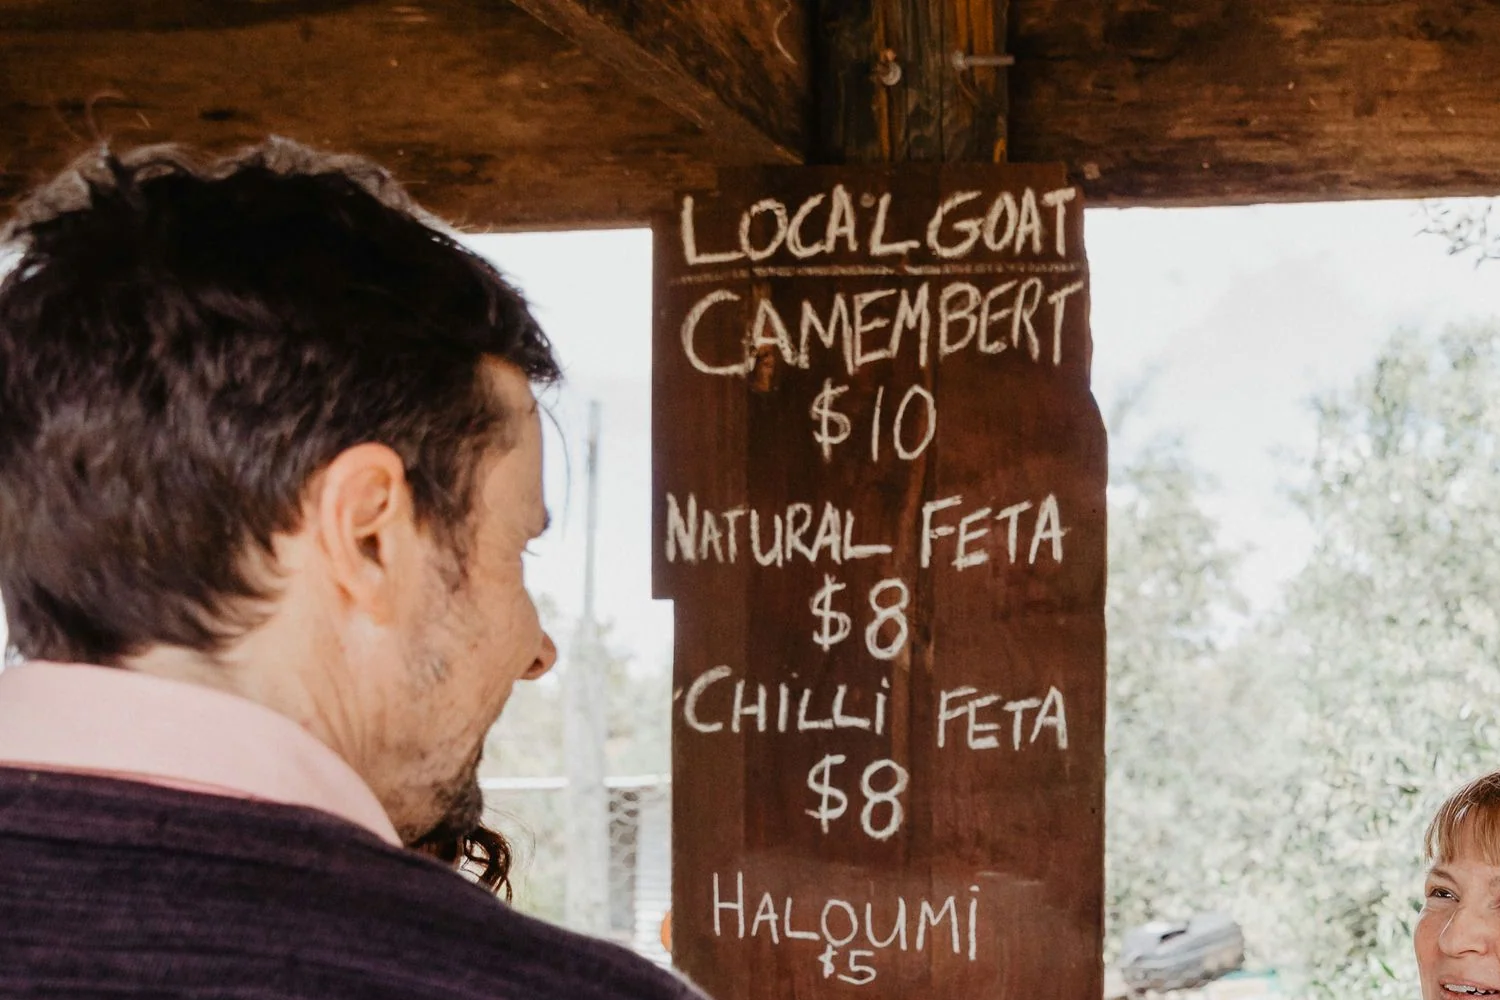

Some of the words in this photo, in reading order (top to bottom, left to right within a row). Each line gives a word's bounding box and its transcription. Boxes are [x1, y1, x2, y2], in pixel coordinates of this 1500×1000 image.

[681, 184, 920, 265] LOCAL
[926, 186, 1077, 258] GOAT
[680, 279, 1085, 376] CAMEMBERT
[810, 380, 937, 462] $10
[665, 492, 893, 568] NATURAL
[920, 493, 1070, 571] FETA
[810, 573, 910, 660] $8
[936, 685, 1069, 751] FETA
[804, 753, 910, 841] $8
[817, 943, 878, 986] $5
